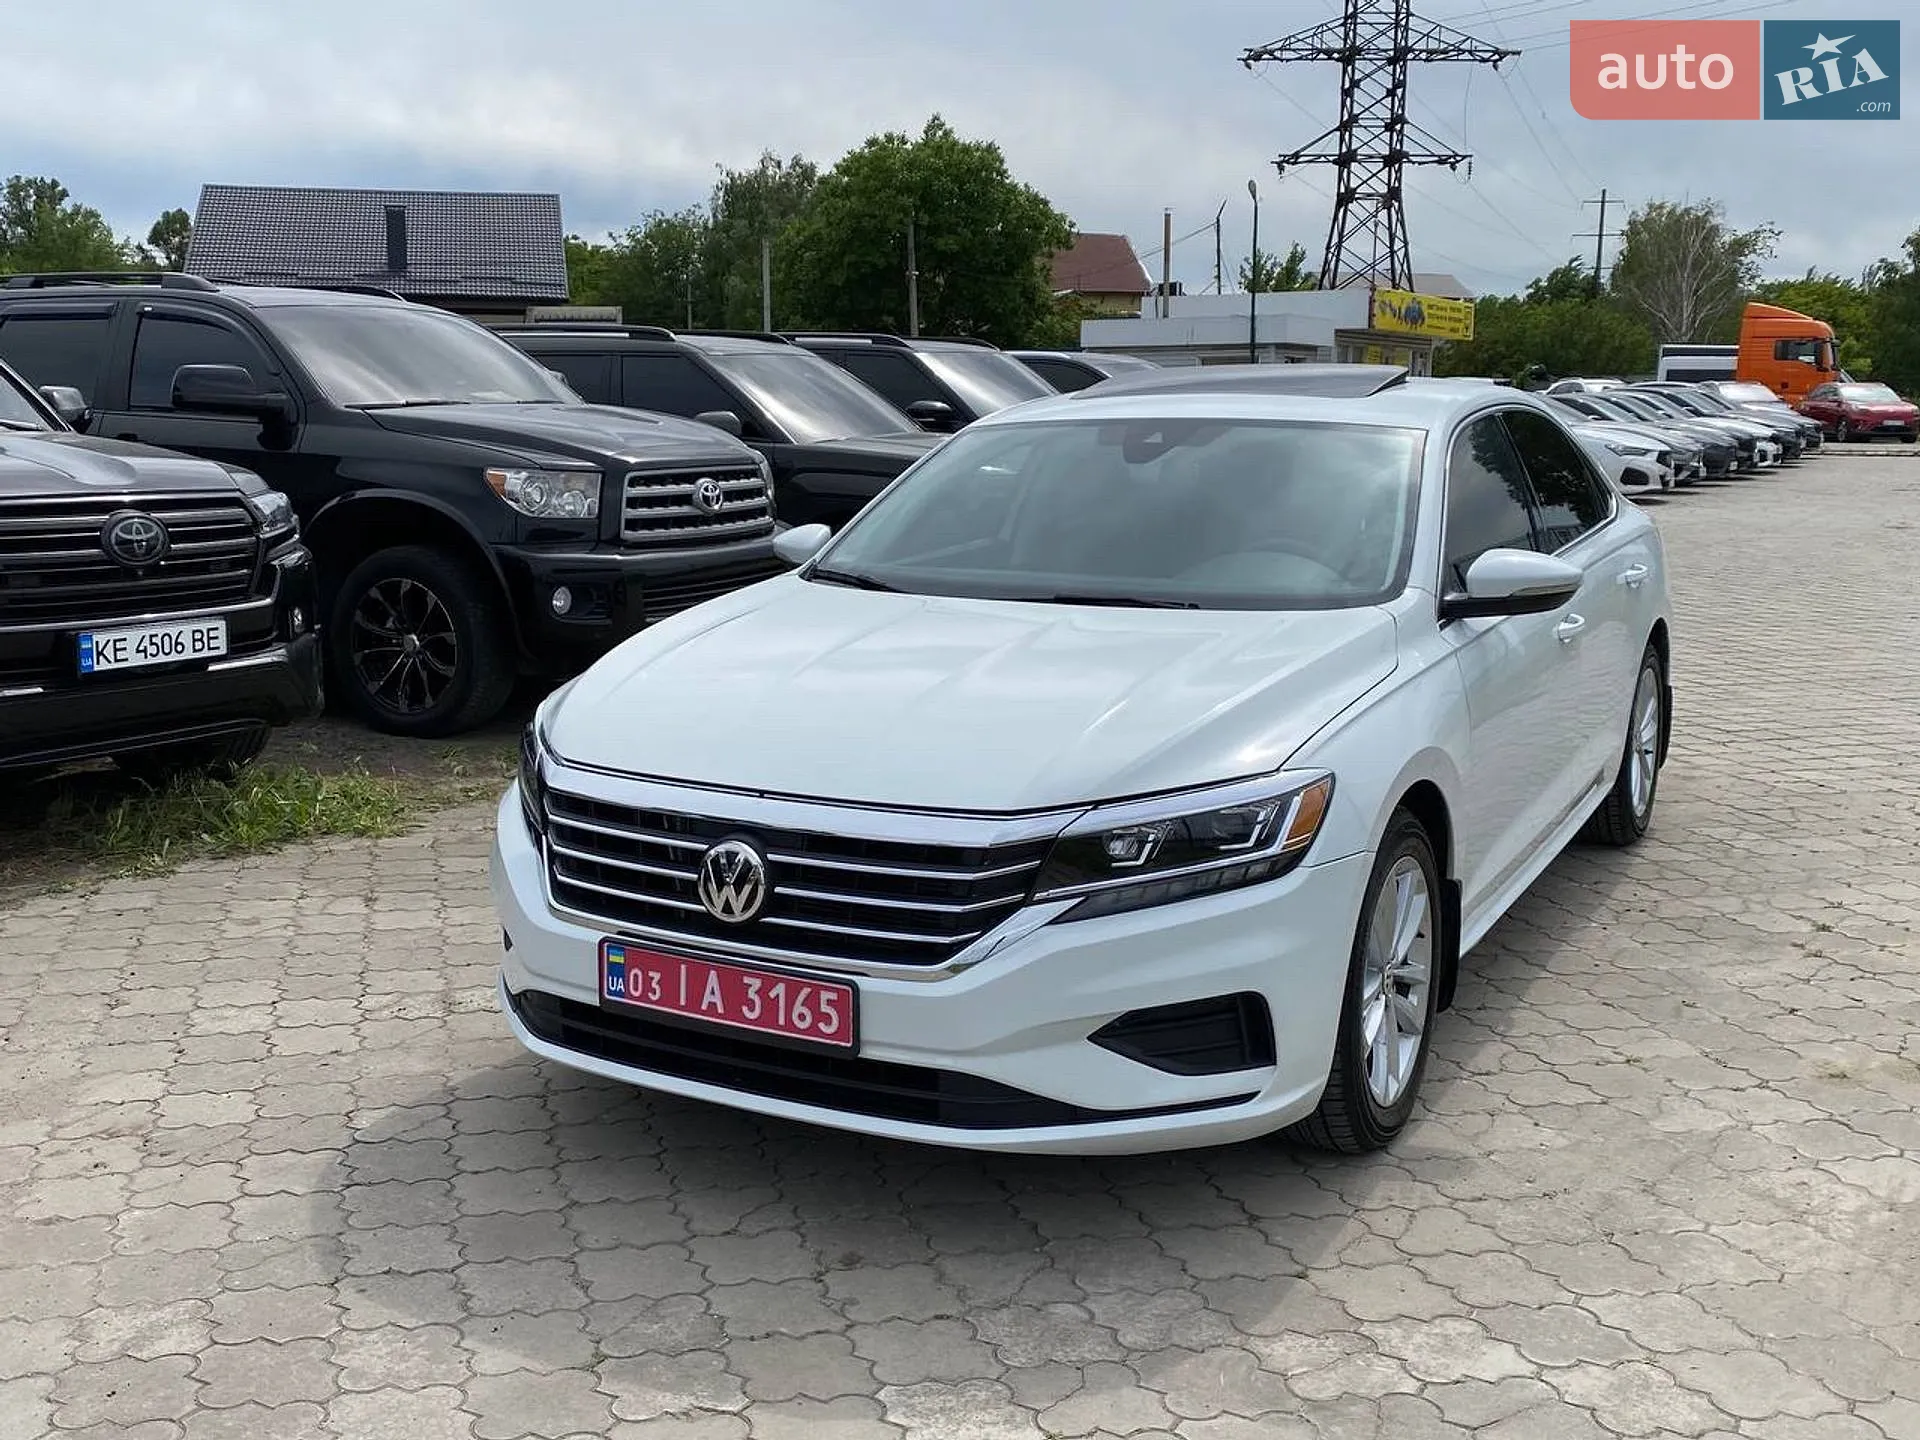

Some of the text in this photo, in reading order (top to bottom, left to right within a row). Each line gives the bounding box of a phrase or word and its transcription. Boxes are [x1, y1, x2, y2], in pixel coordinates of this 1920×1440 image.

[95, 627, 220, 666] KE 4506 BE
[608, 975, 625, 993] UA
[629, 964, 840, 1035] 03 IA 3165
